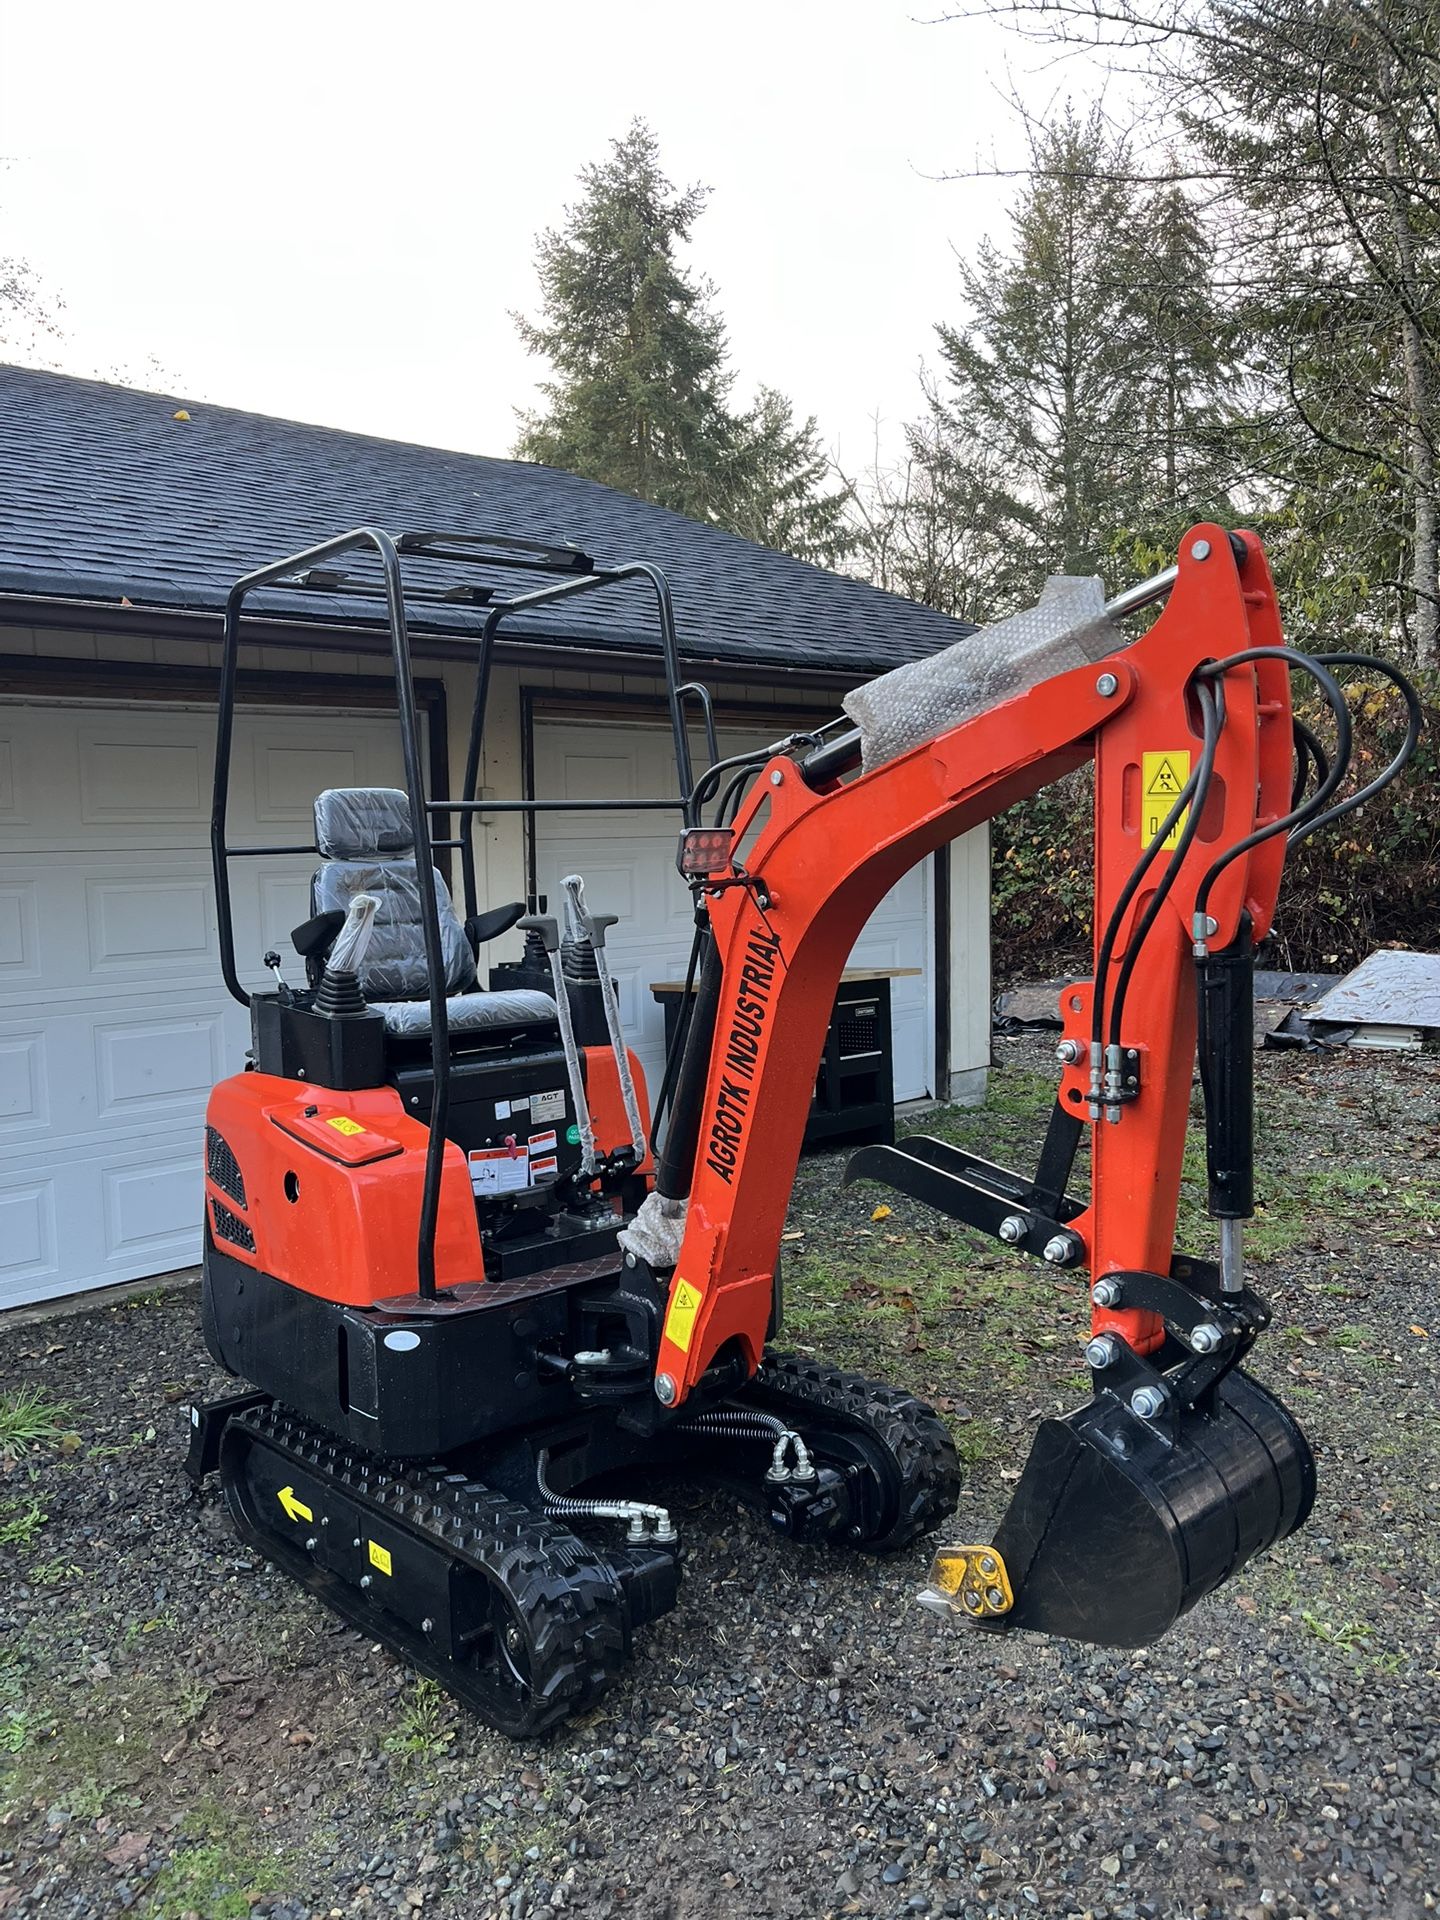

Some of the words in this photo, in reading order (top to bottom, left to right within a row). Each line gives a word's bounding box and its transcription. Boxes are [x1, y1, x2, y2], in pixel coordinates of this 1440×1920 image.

[725, 929, 780, 1081] INDUSTRIAL
[541, 1092, 559, 1101] AGT
[706, 1077, 750, 1185] AGROTK
